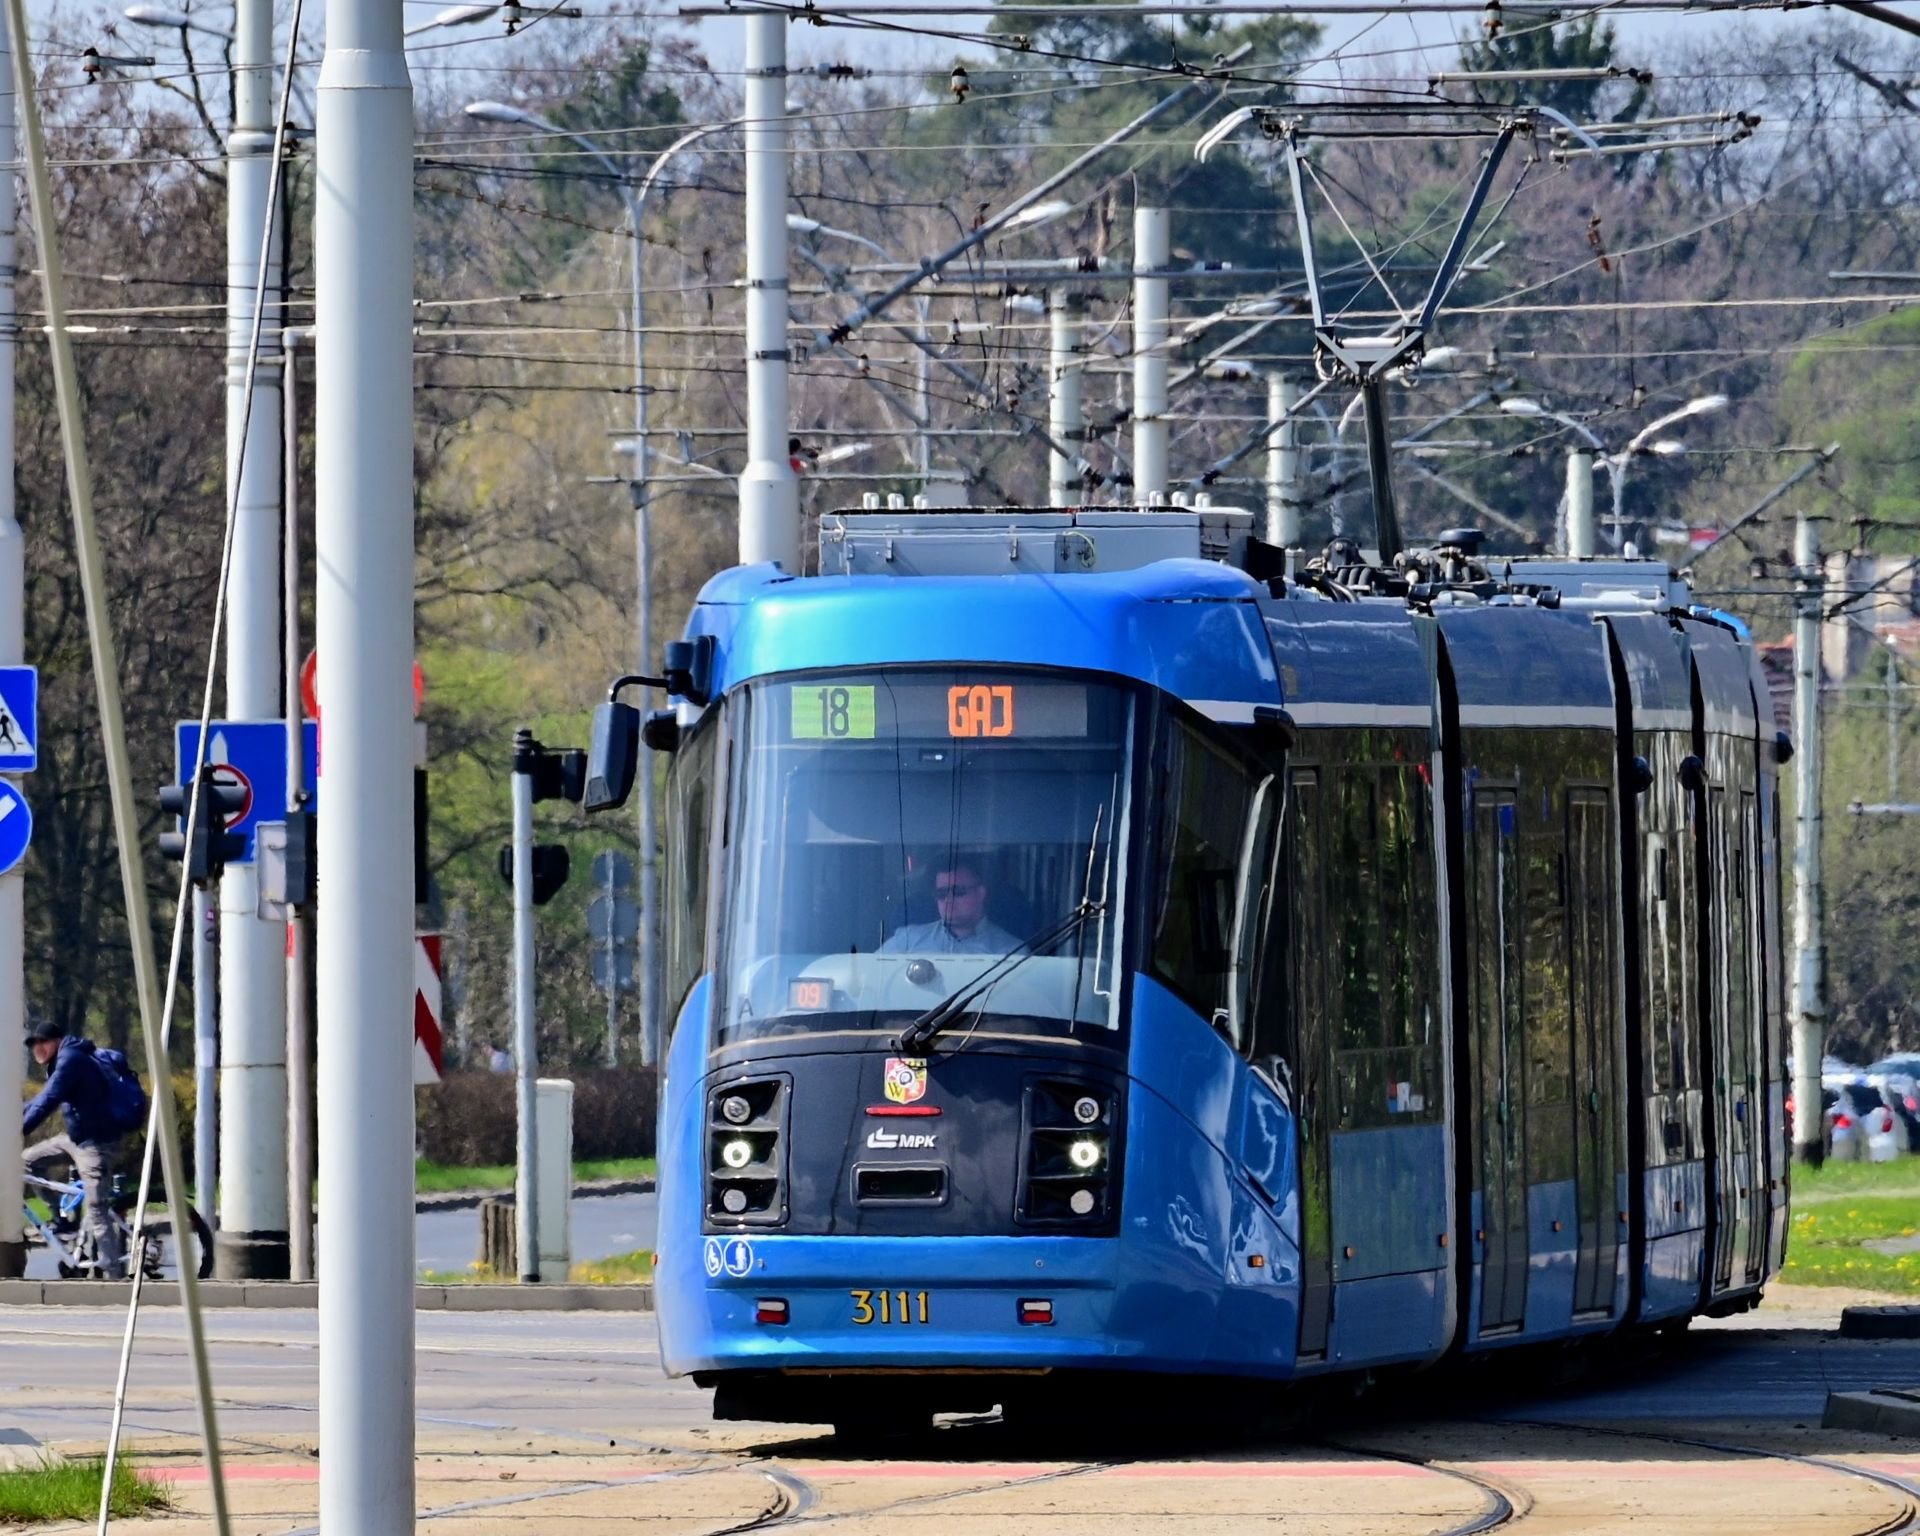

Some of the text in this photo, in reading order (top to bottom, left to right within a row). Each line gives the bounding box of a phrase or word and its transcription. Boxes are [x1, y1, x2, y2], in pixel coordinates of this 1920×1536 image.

[817, 687, 850, 737] 18
[947, 684, 1013, 738] GAJ
[796, 983, 821, 1009] 09
[898, 1133, 937, 1149] MPK
[849, 1289, 928, 1325] 3111
